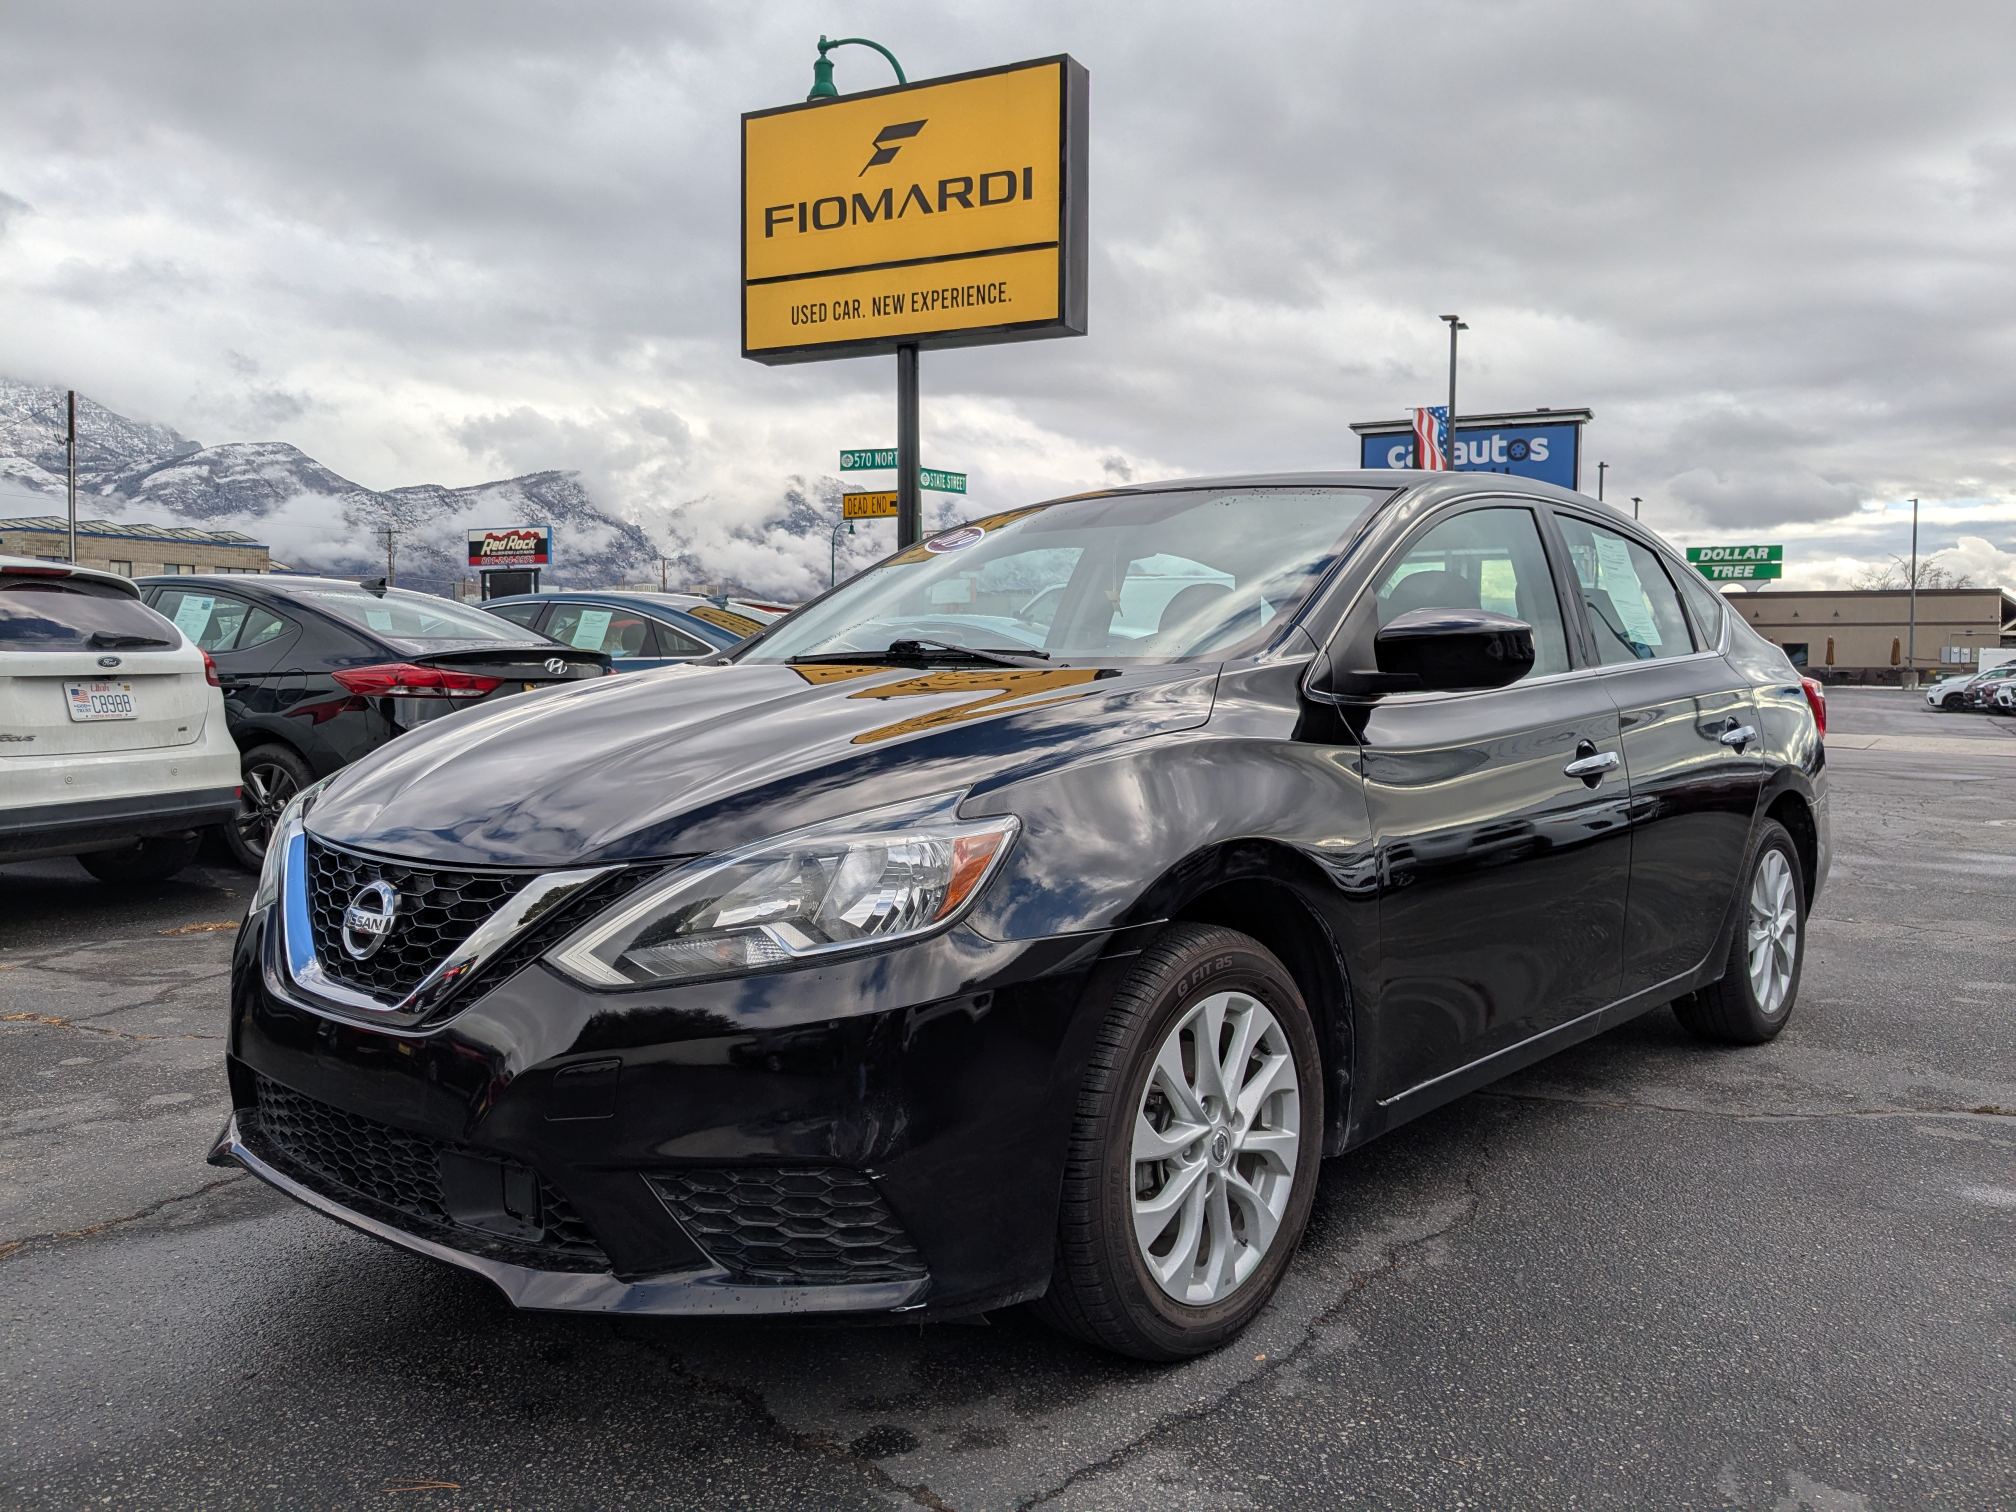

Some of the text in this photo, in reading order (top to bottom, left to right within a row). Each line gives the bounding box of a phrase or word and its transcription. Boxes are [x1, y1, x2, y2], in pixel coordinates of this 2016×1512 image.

[764, 166, 1033, 238] FIOMARDI
[791, 281, 1012, 326] USED CAR. NEW EXPERIENCE.
[854, 451, 898, 467] 570 NORT
[930, 472, 966, 491] STATE STREET
[847, 495, 887, 515] DEAD END
[480, 535, 538, 555] Red Rock
[1699, 547, 1769, 561] DOLLAR
[1711, 565, 1755, 578] TREE
[1177, 979, 1189, 998] G
[1192, 961, 1212, 985] FIT
